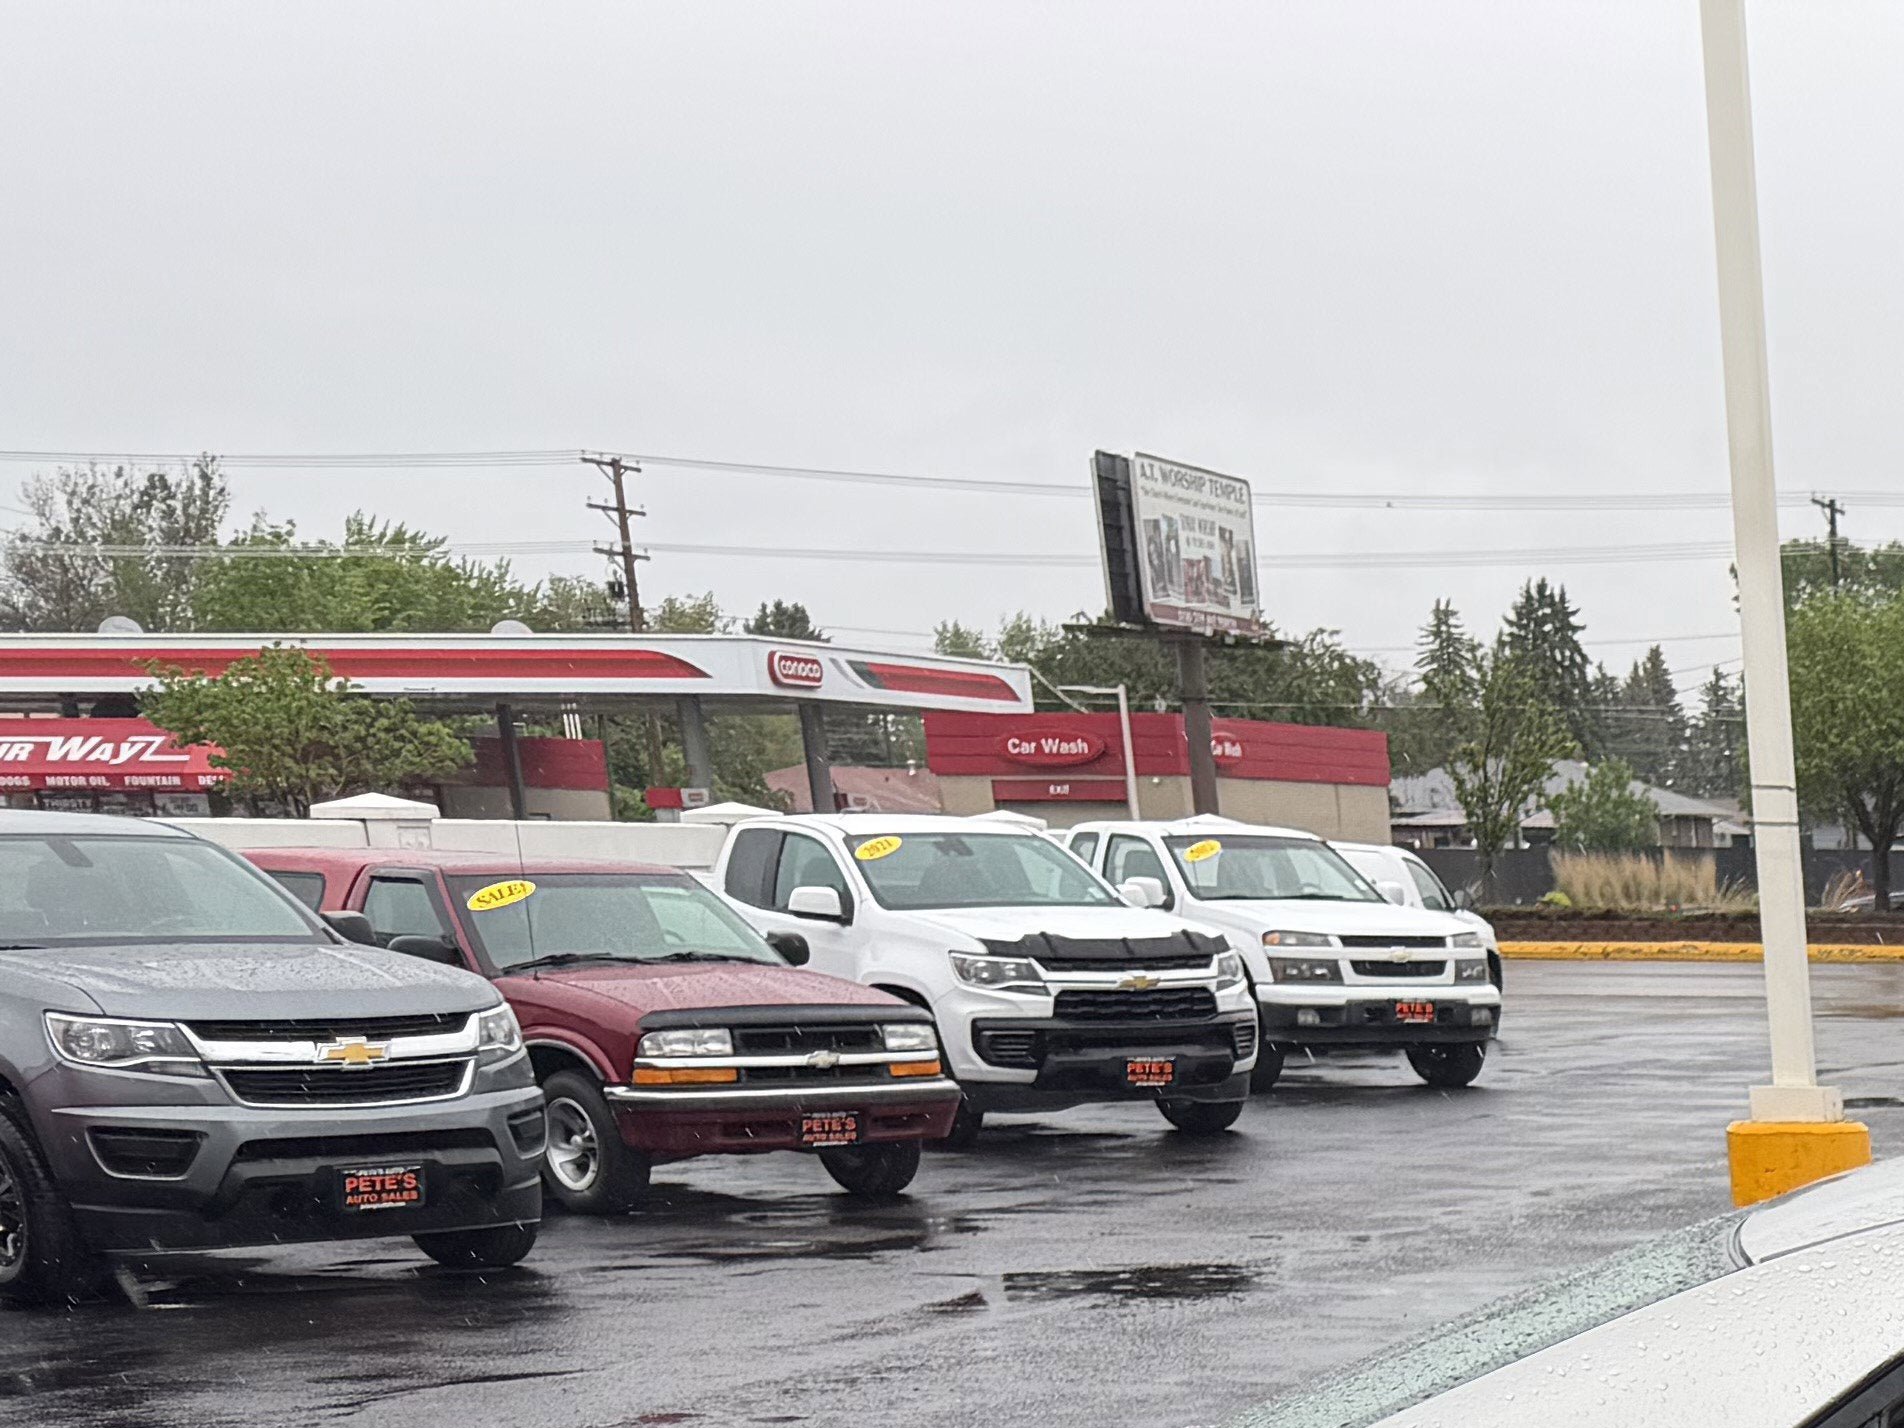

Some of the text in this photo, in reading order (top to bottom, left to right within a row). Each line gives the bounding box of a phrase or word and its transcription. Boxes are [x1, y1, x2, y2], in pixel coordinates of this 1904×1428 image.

[1007, 738, 1089, 755] Car Wash
[45, 776, 87, 787] MOTOR
[124, 776, 181, 787] FOUNTAIN
[345, 1173, 418, 1193] PETE'S
[346, 1190, 419, 1205] AUTO SALES
